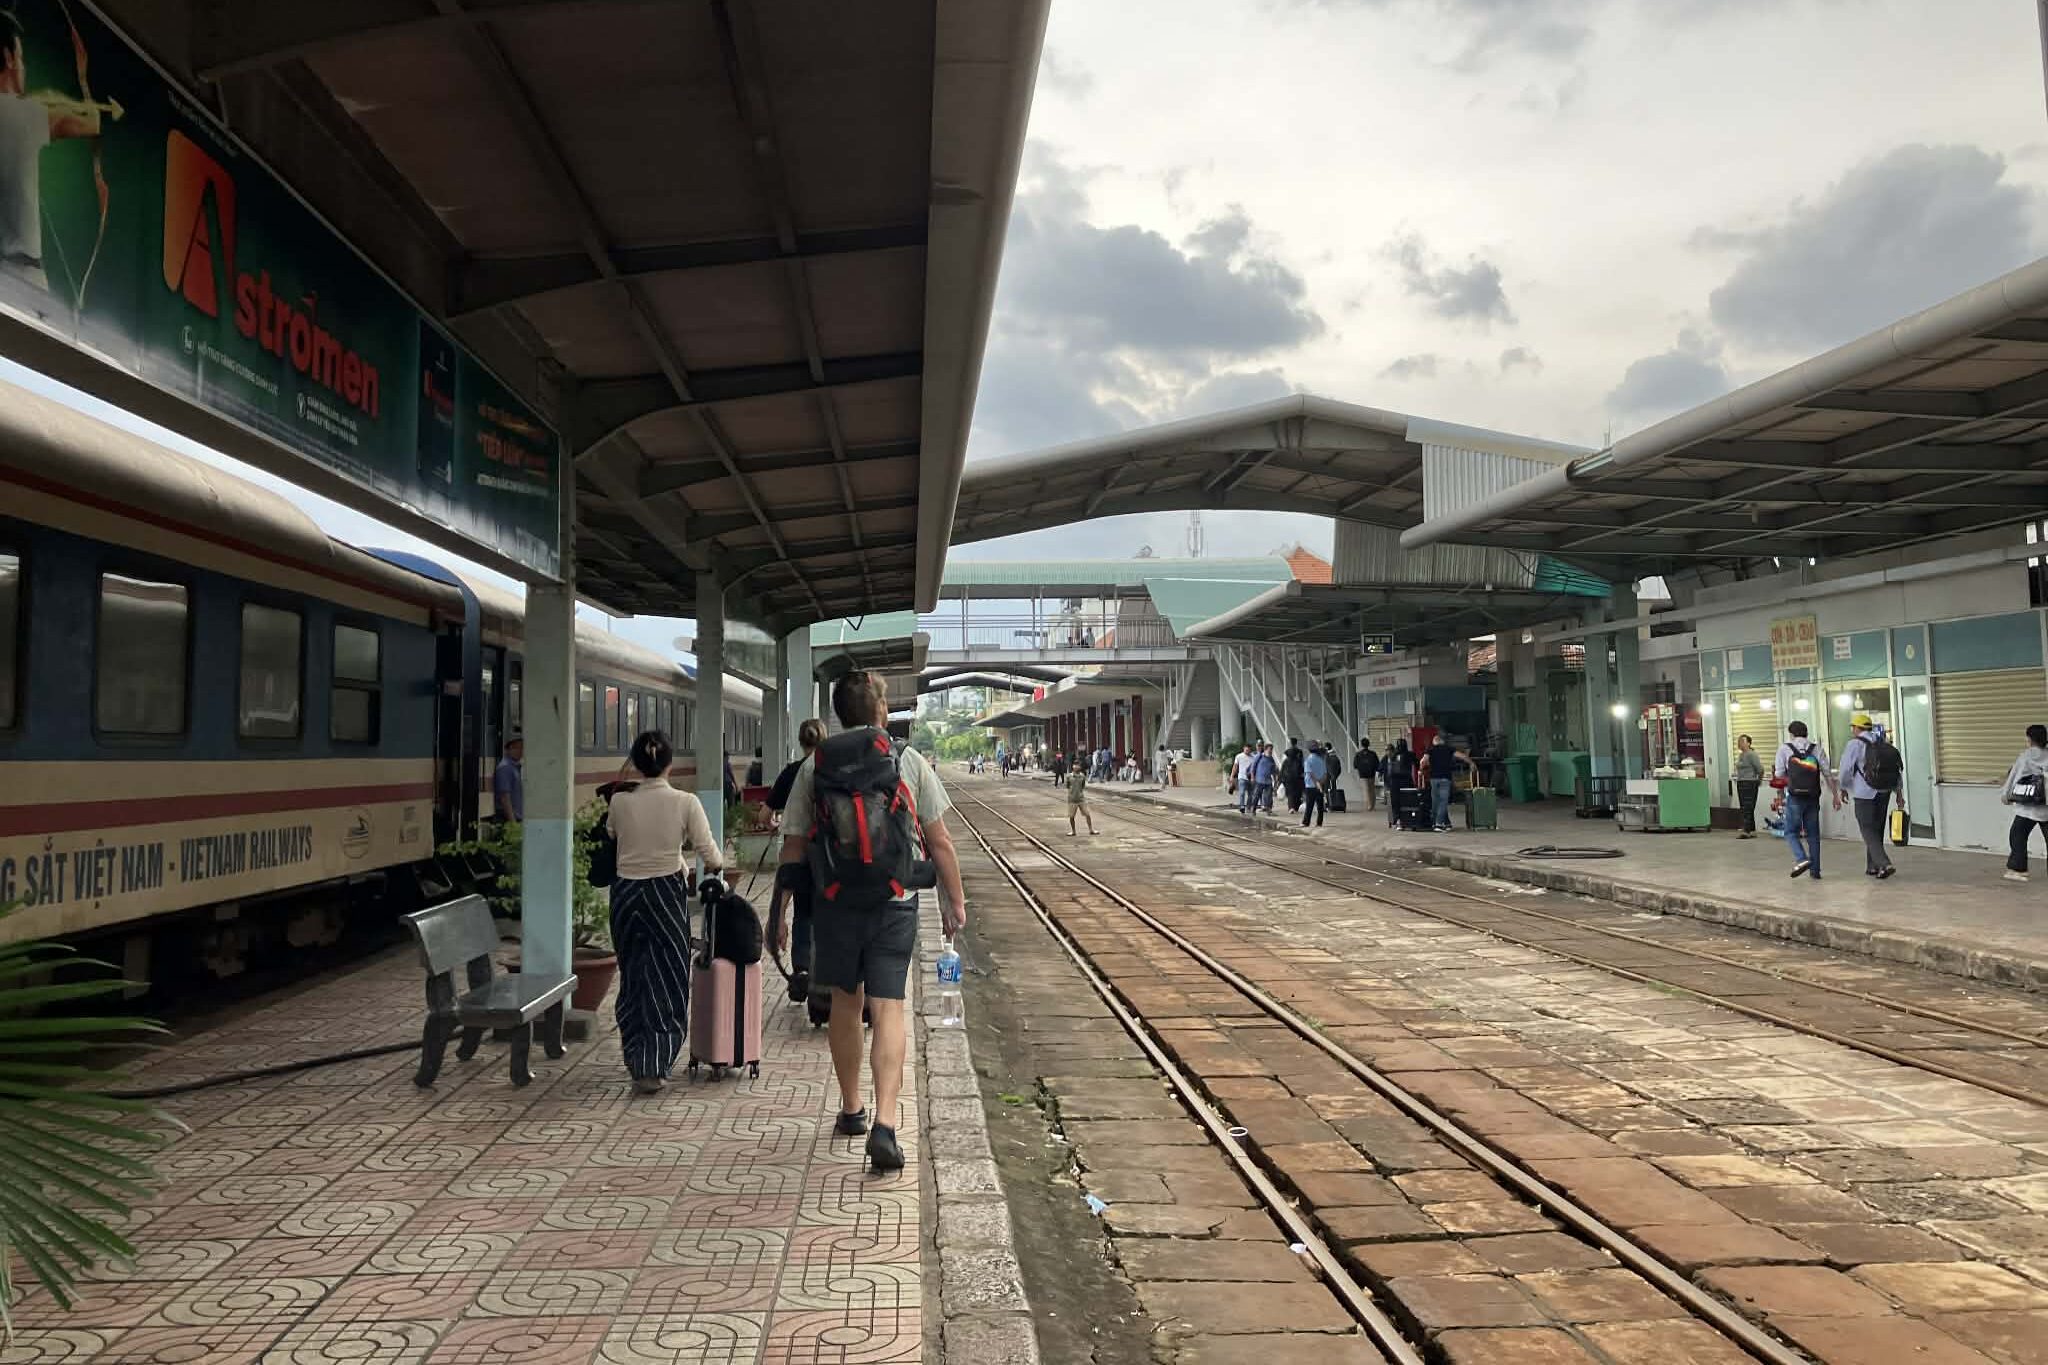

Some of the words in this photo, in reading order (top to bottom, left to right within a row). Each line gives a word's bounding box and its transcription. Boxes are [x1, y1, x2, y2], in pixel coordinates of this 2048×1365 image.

[24, 836, 67, 907] SẮT
[74, 838, 116, 909] VIỆT
[120, 842, 163, 893] NAM
[181, 832, 246, 882] VIETNAM
[250, 824, 312, 870] RAILWAYS
